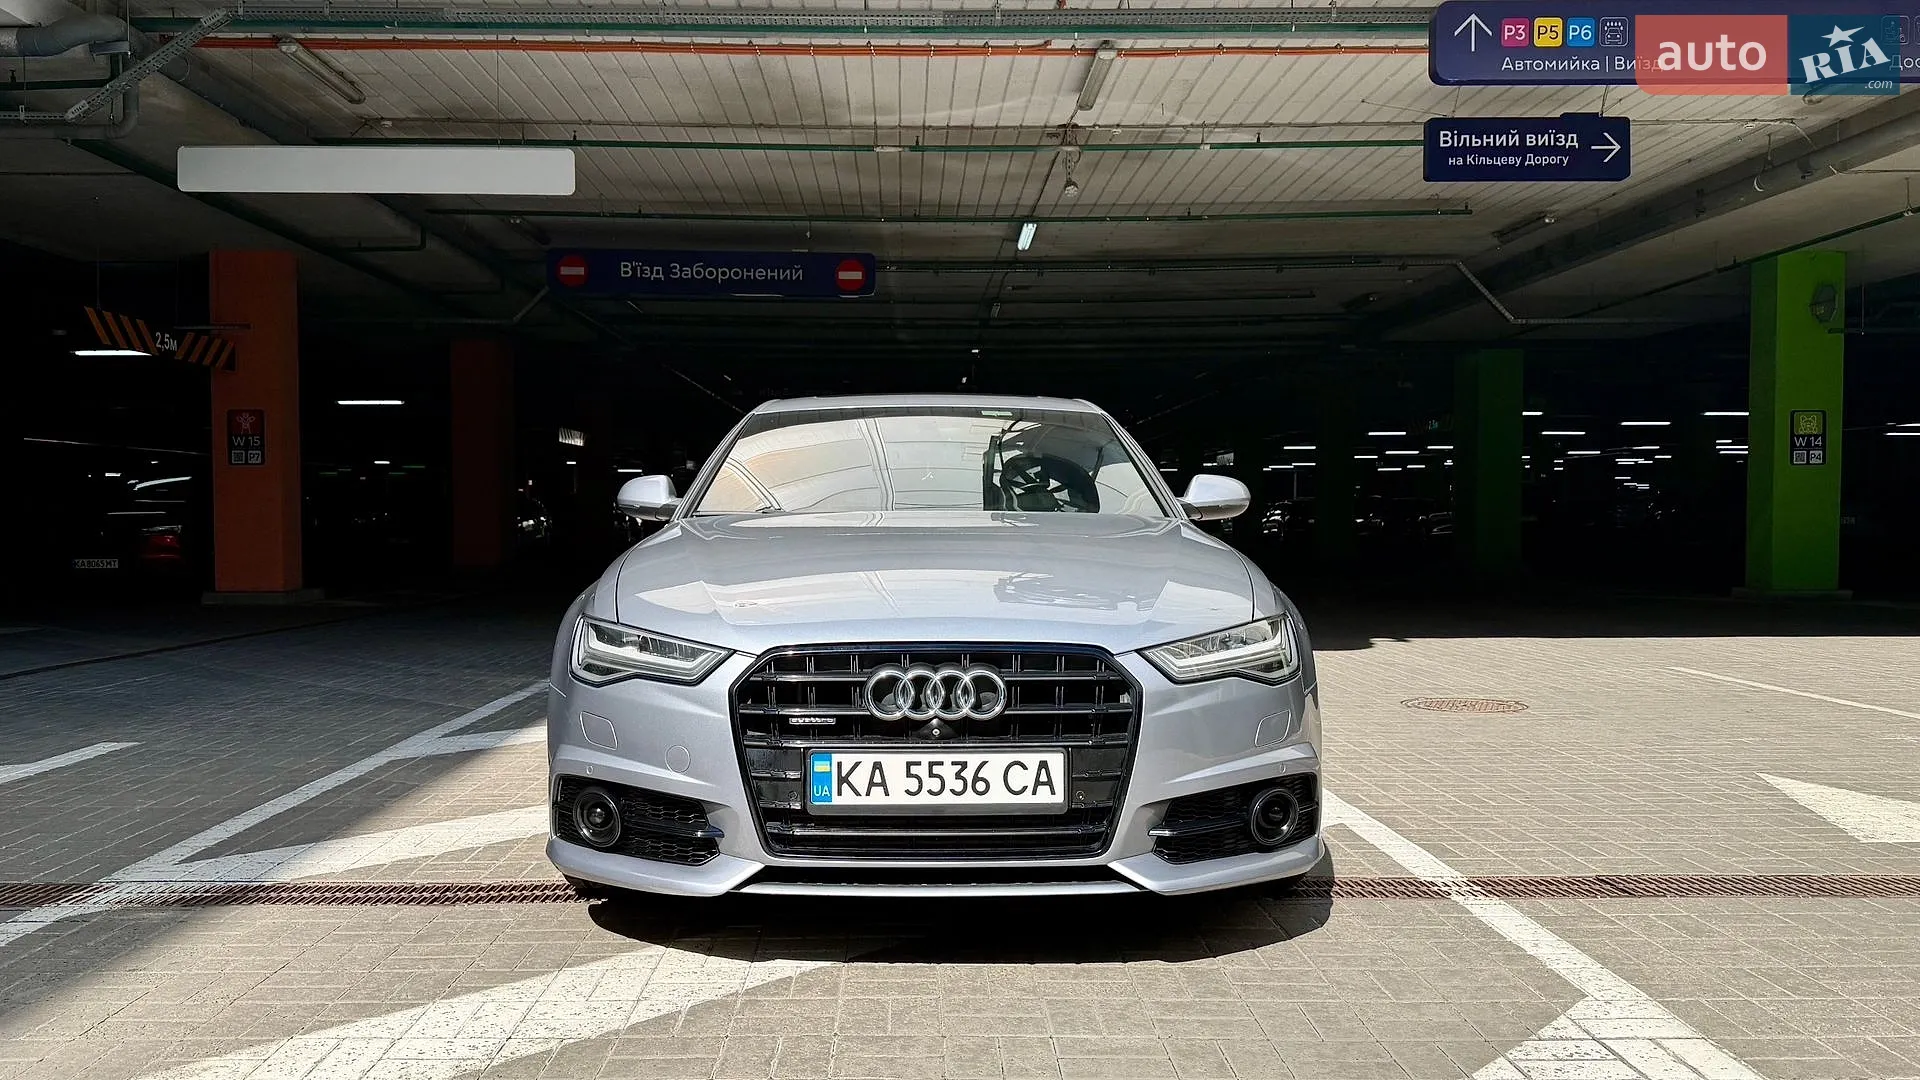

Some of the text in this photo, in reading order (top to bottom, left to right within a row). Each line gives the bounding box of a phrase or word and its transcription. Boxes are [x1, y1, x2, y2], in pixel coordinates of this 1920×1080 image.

[1504, 25, 1592, 40] P3 P5 P6
[1502, 56, 1600, 71] Автомийка
[1439, 130, 1579, 149] Вільний виїзд
[1448, 154, 1569, 167] на Кільцеву Дорогу
[669, 262, 804, 284] Заборонений
[1794, 436, 1823, 447] W 14
[836, 760, 1056, 797] KA 5536 CA
[813, 784, 831, 797] UA
